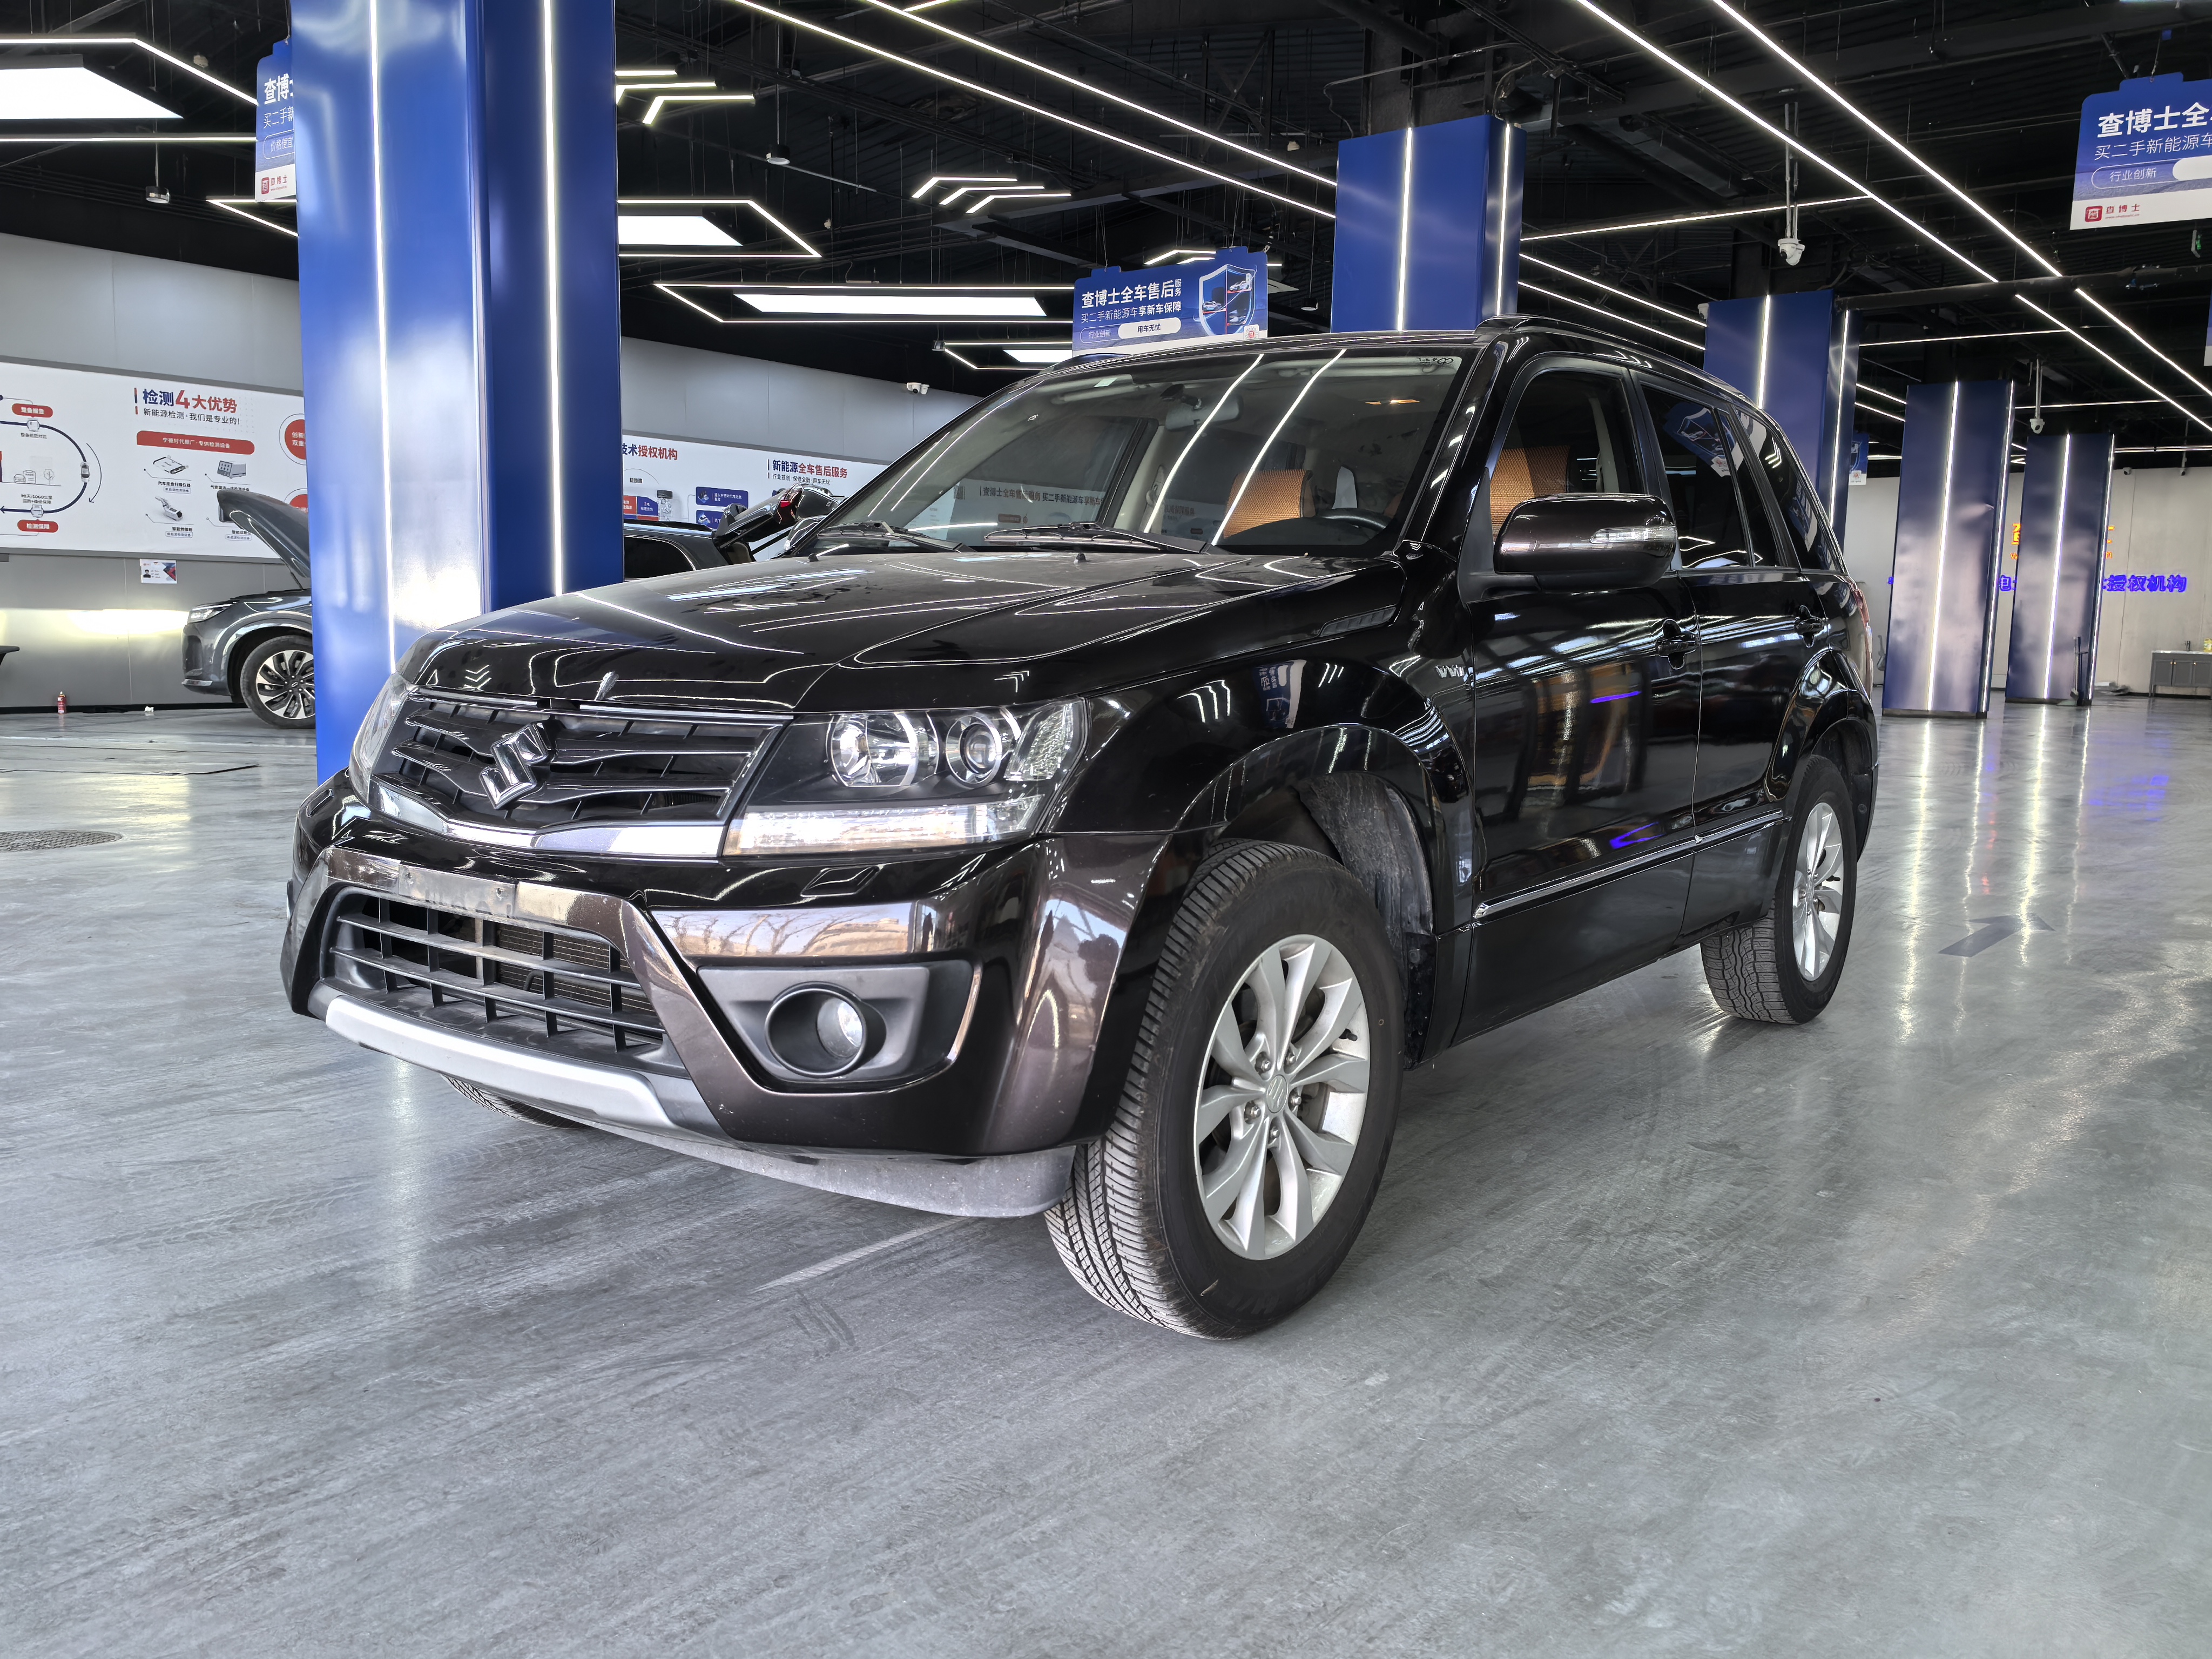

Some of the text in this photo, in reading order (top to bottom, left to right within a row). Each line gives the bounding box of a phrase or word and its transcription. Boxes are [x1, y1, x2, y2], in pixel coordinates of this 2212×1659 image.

[264, 73, 293, 105] 查博
[2097, 102, 2212, 138] 查博士全
[271, 137, 293, 153] 价格便宜
[2109, 167, 2156, 182] 行业创新
[1081, 300, 1182, 324] 买二手新能源车享新车保障
[1088, 329, 1111, 339] 行业创新
[1137, 323, 1161, 333] 用车无忧
[142, 388, 238, 413] 检测4大优势
[772, 460, 847, 478] 新能源全车售后服务
[2102, 575, 2187, 592] 授权机构
